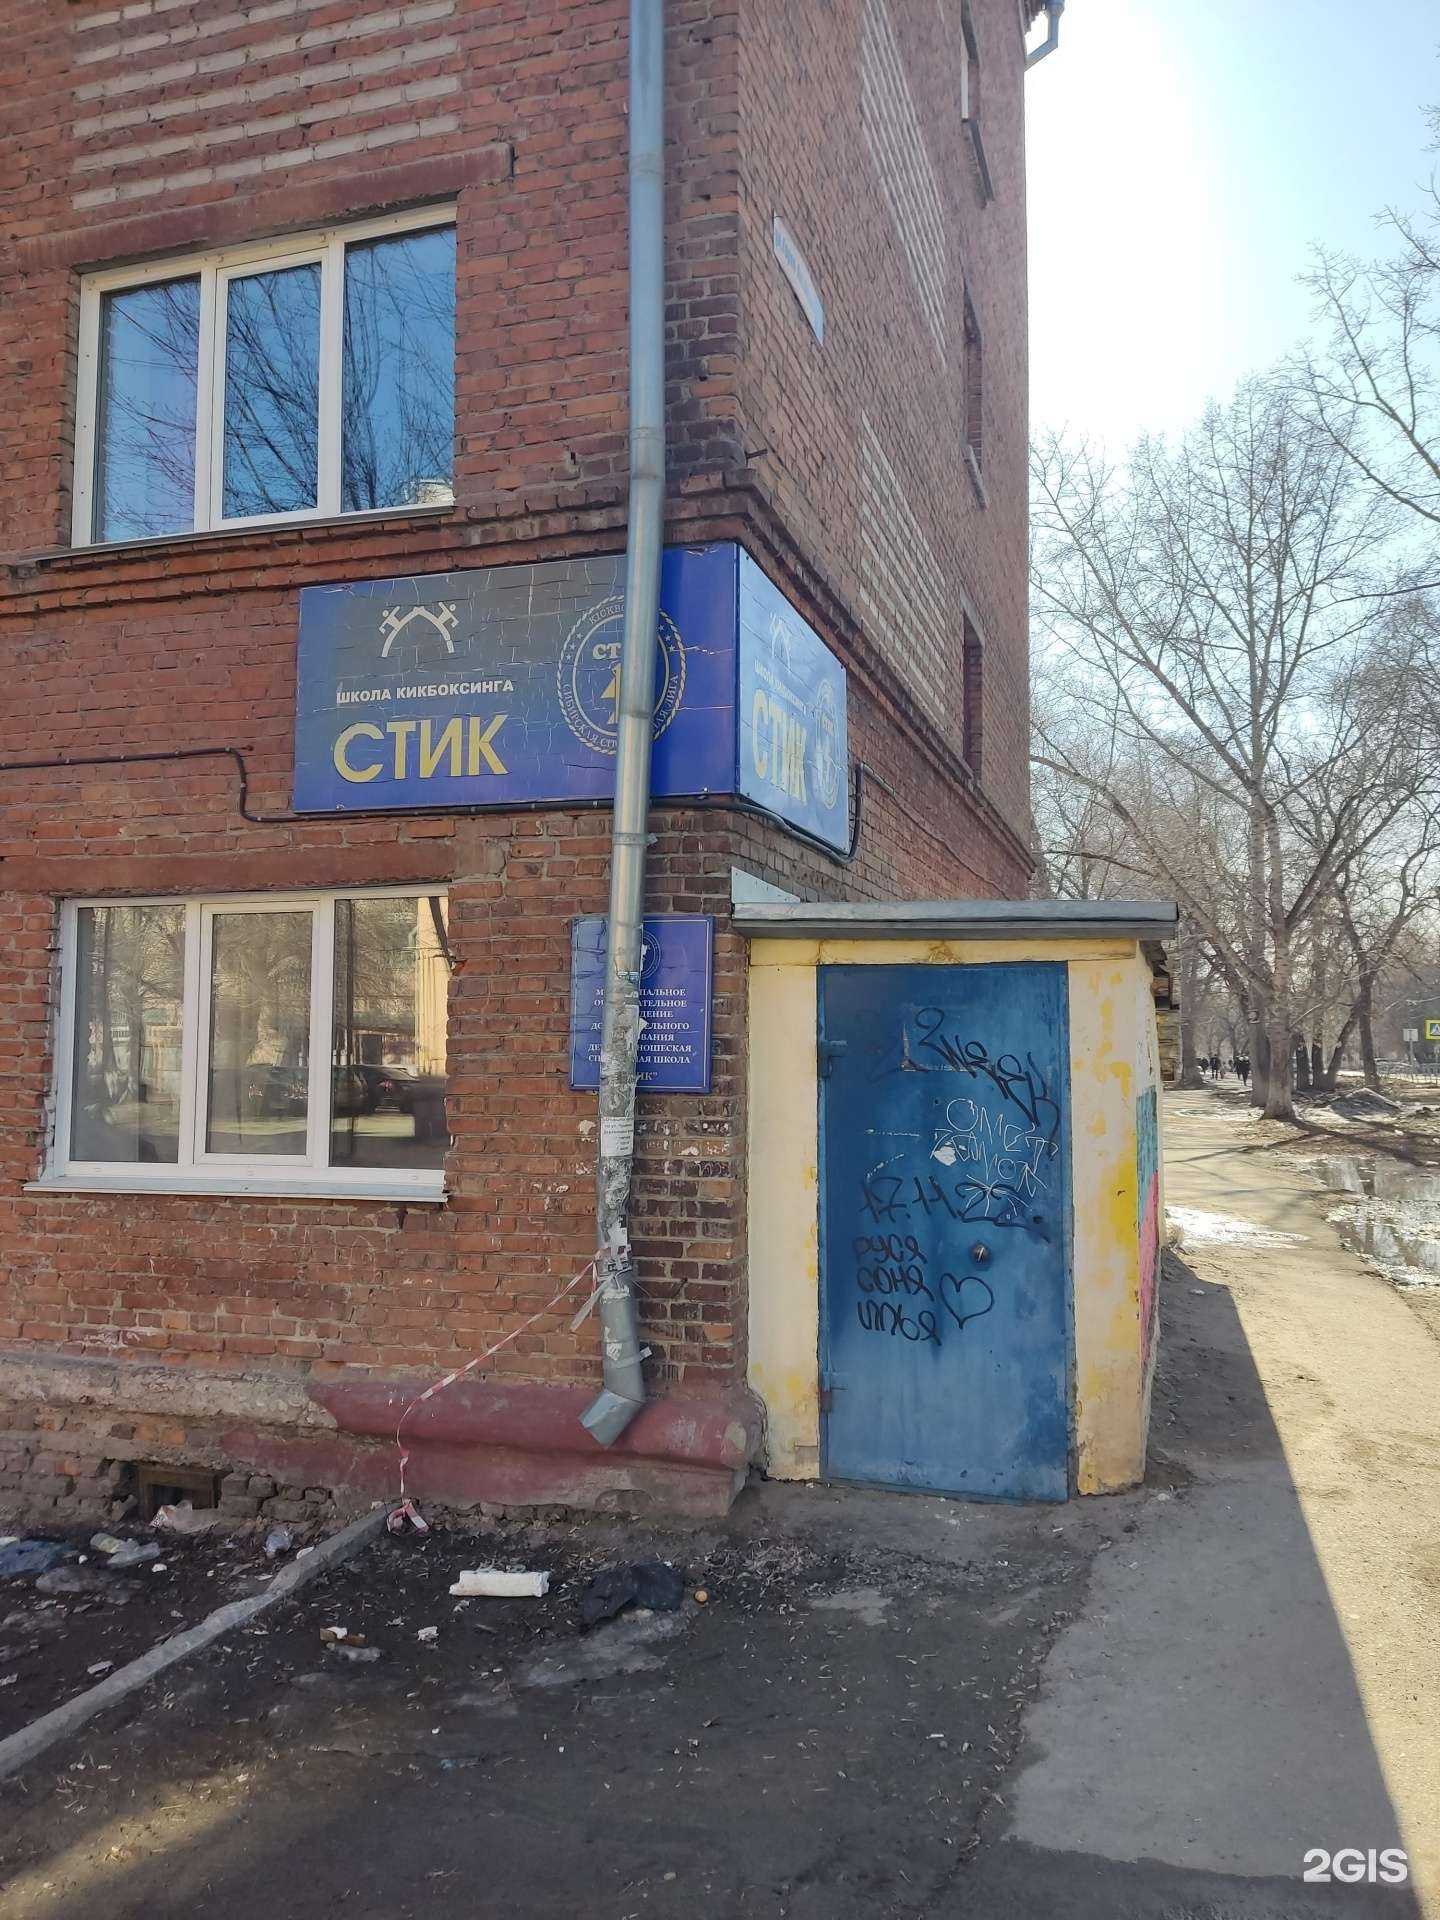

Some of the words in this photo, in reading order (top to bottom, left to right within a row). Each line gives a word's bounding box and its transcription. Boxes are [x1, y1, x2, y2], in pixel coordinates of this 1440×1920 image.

[336, 688, 392, 704] ШКОЛА
[396, 679, 514, 699] КИКБОКСИНГА
[333, 714, 510, 783] СТИК
[752, 688, 807, 806] СТИК
[653, 1056, 691, 1065] ШКОЛА
